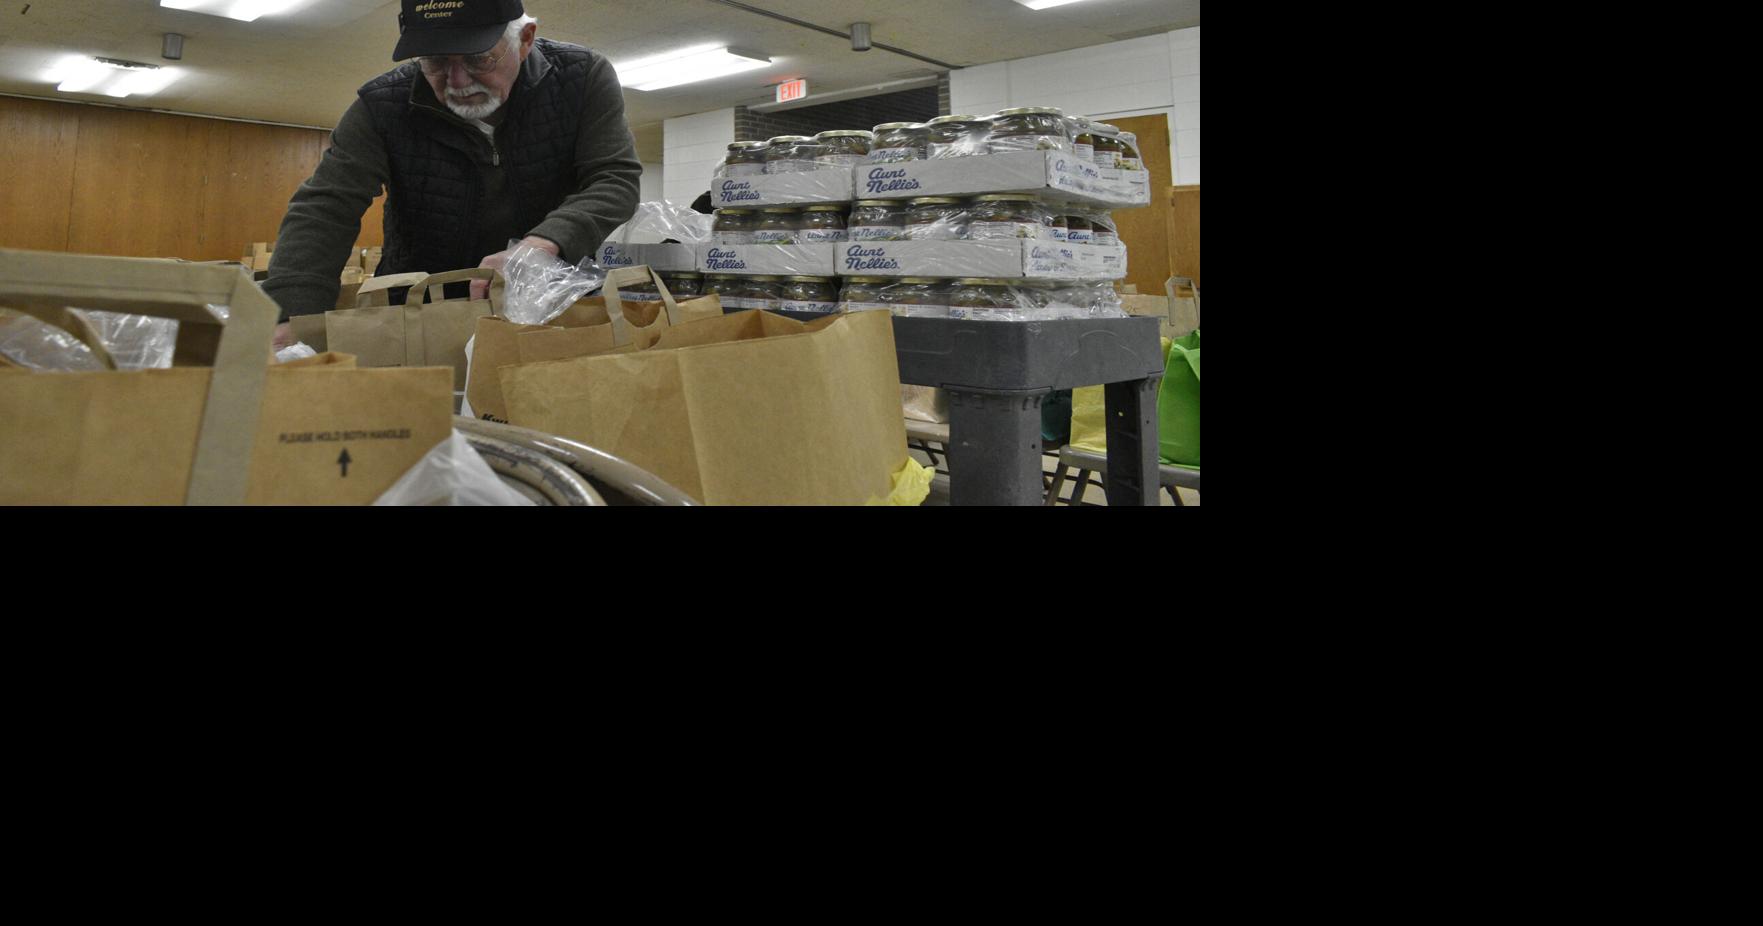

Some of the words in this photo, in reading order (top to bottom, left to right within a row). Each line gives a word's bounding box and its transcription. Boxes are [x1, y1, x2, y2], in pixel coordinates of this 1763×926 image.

[424, 11, 452, 19] Center
[781, 82, 801, 100] EXIT
[867, 167, 905, 180] Aunt
[722, 180, 751, 191] Aunt
[708, 248, 736, 259] Aunt
[847, 244, 885, 257] Aunt
[279, 432, 314, 443] PLEASE
[343, 430, 368, 440] BOTH
[370, 428, 411, 440] HANDLES
